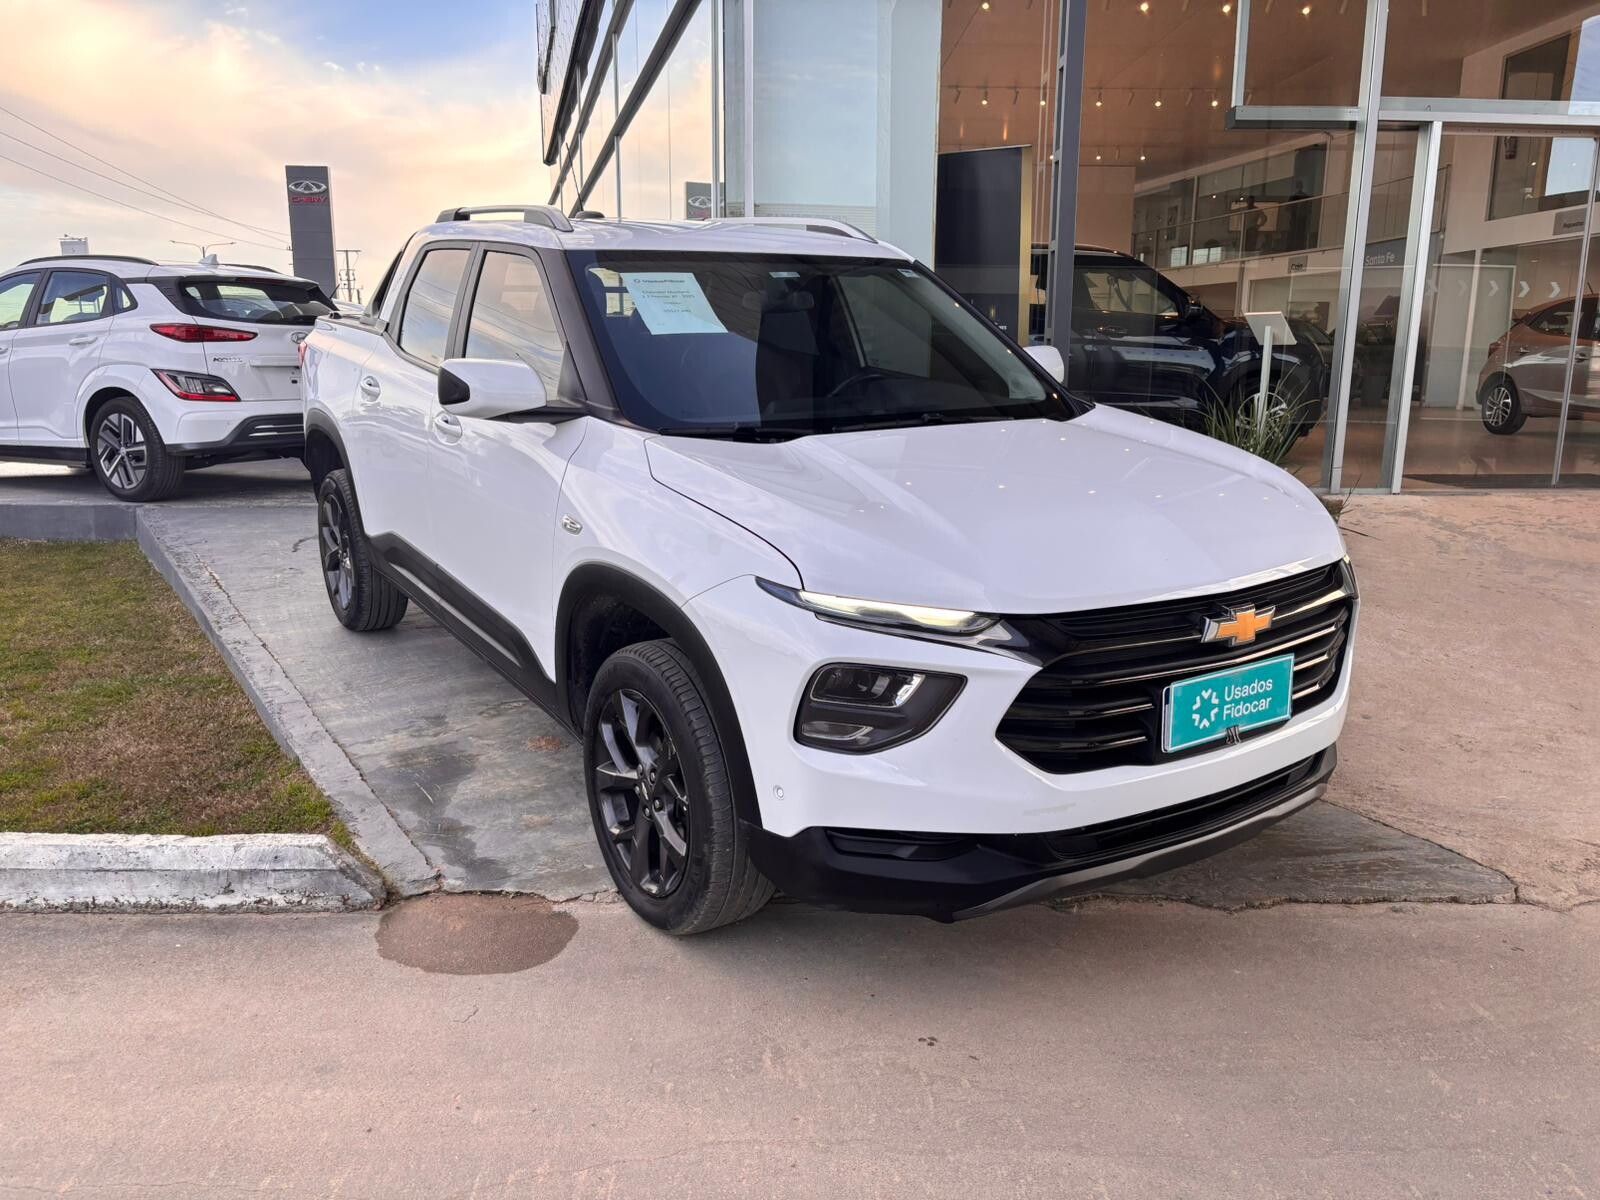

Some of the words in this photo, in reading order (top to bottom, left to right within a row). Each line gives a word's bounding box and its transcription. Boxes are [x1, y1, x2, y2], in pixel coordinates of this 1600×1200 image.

[1365, 254, 1384, 266] Santa
[1224, 678, 1273, 702] Usados
[1223, 697, 1272, 721] Fidocar
